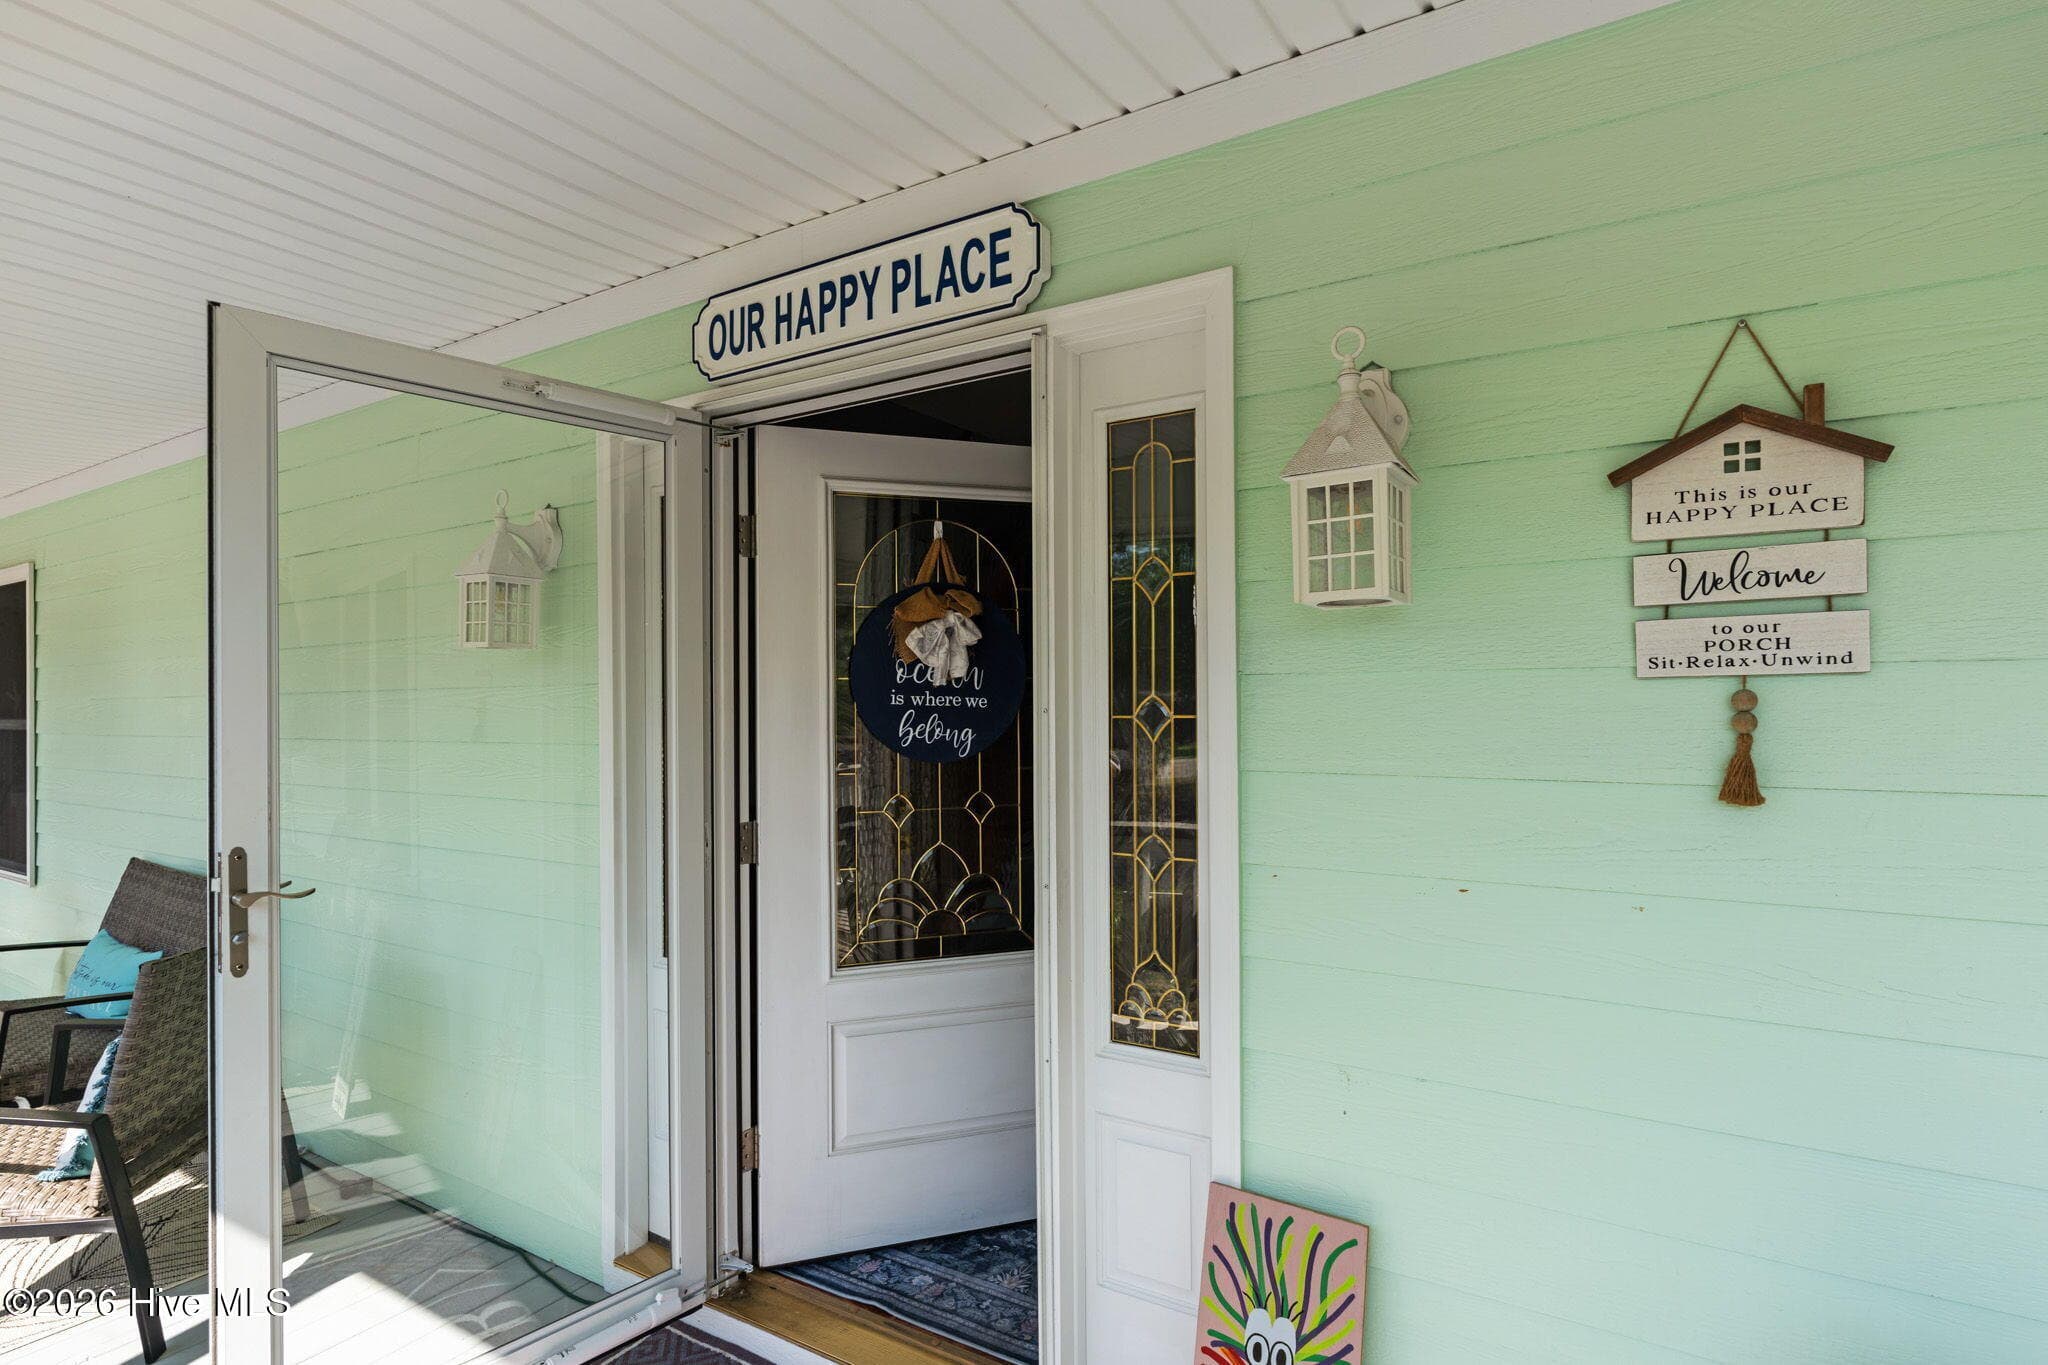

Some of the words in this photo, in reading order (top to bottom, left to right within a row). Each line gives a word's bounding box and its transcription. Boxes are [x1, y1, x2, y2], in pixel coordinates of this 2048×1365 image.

[708, 302, 766, 361] OUR
[775, 265, 881, 345] HAPPY
[891, 227, 1013, 314] PLACE
[1675, 489, 1727, 504] This
[1739, 485, 1757, 499] is
[1768, 482, 1813, 497] our
[1646, 505, 1737, 525] HAPPY
[1750, 496, 1849, 518] PLACE
[1668, 550, 1826, 601] Welcome
[1712, 624, 1733, 635] to
[1742, 622, 1782, 634] our
[1704, 637, 1792, 652] PORCH
[890, 689, 905, 705] is
[911, 691, 962, 707] where
[964, 696, 988, 708] we
[898, 709, 977, 758] belong
